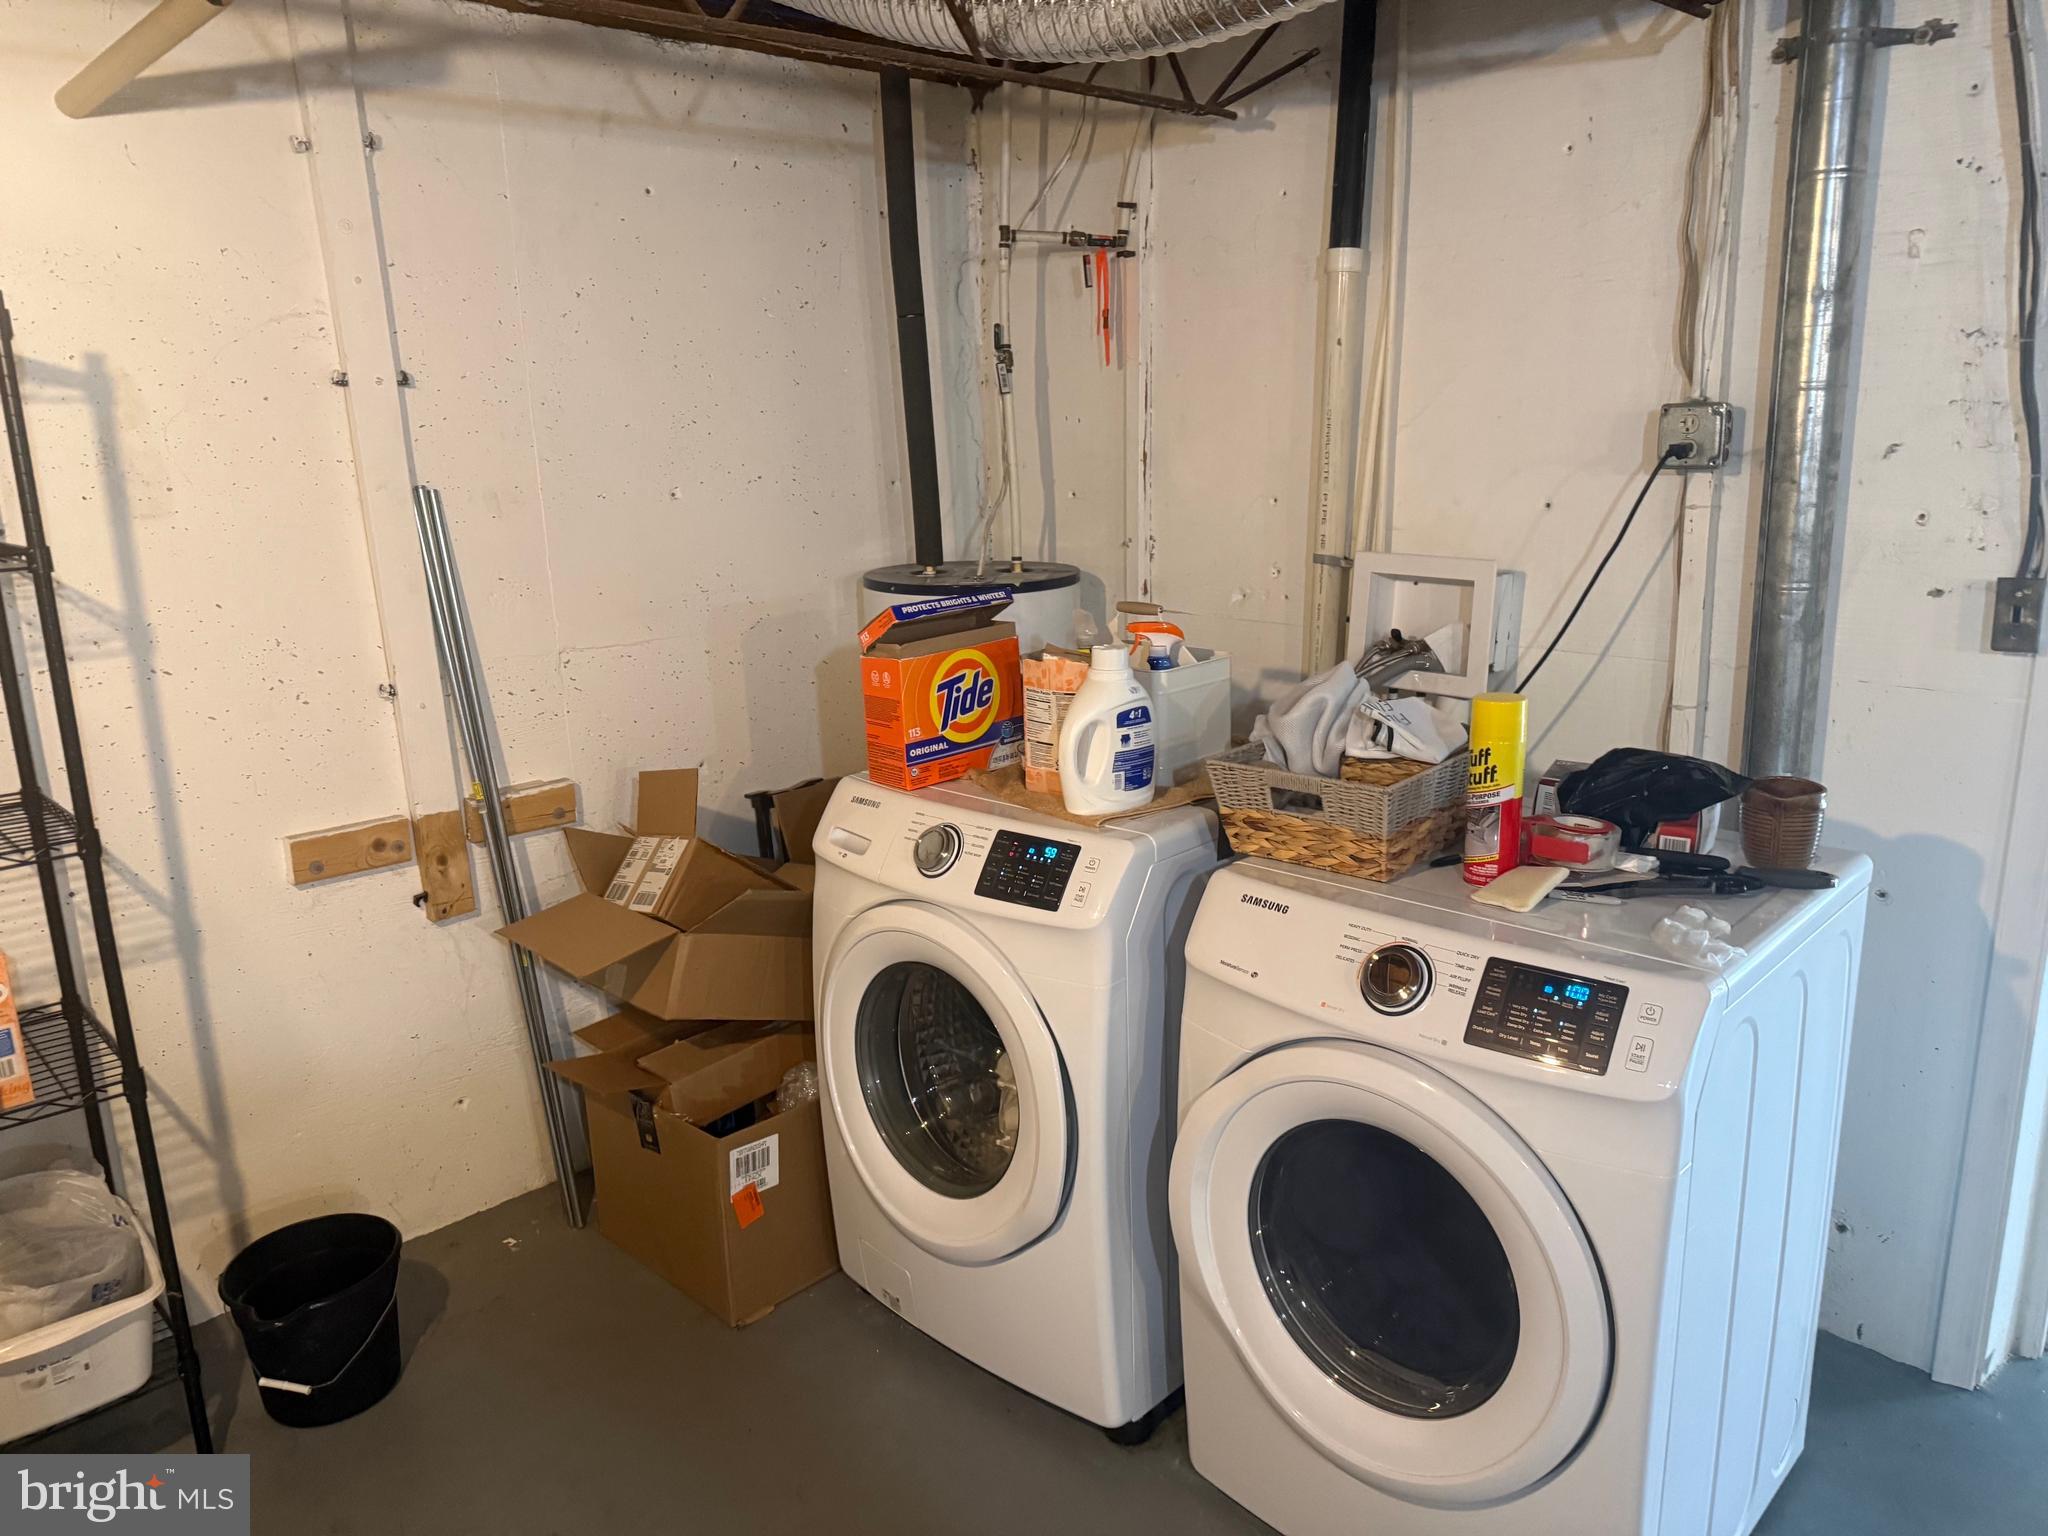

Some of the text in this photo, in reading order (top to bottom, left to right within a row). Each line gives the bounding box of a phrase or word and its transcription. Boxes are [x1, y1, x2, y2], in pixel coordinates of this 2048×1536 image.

[901, 602, 941, 615] PROTECTS
[941, 596, 972, 608] BRIGHTS
[978, 591, 1006, 602] WHITES!
[936, 667, 995, 735] Tide
[908, 727, 921, 738] 113
[909, 741, 949, 757] ORIGINAL
[1469, 765, 1497, 786] tuff
[851, 795, 881, 809] SAMSUNG
[1240, 893, 1290, 915] SAMSUNG
